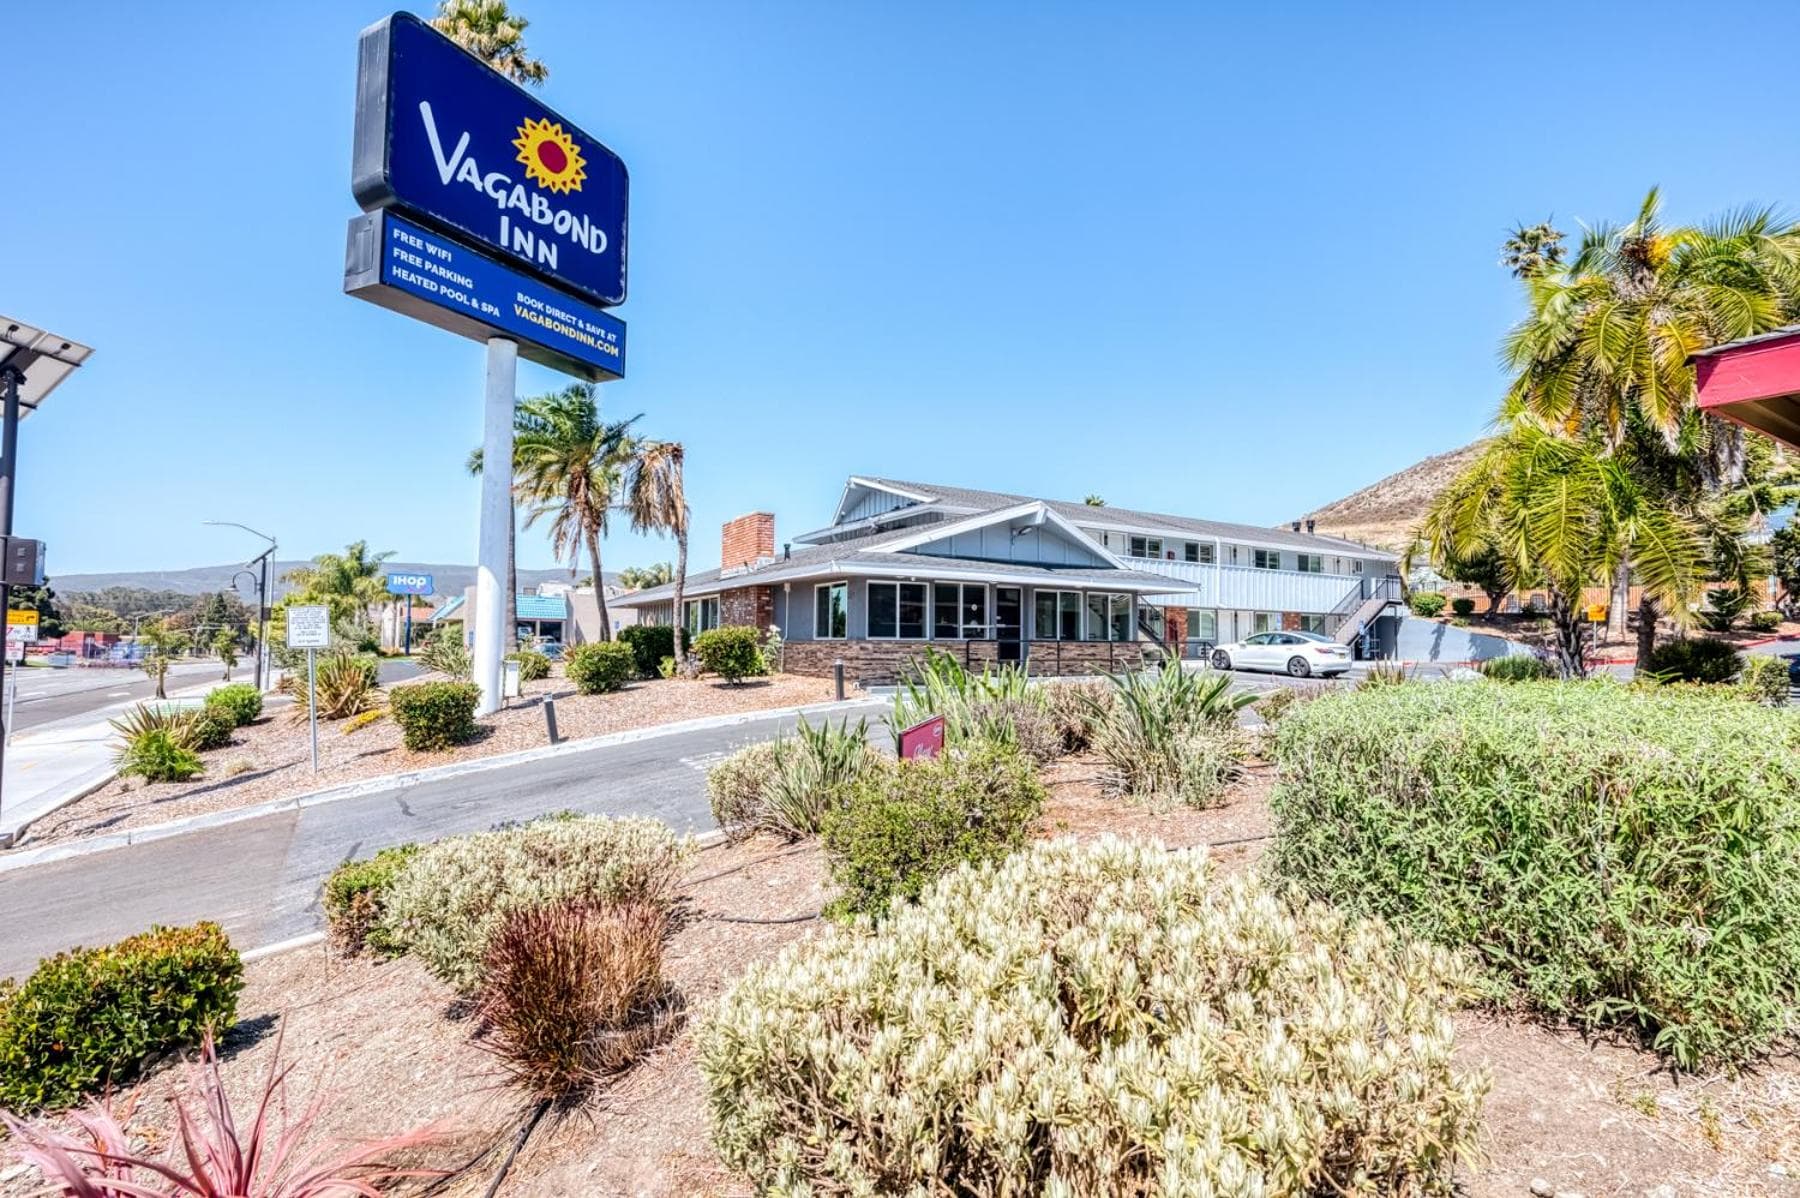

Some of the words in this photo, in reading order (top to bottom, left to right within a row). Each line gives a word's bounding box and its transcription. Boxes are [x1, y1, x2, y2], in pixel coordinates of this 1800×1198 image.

[419, 100, 608, 254] VAGABOND
[393, 228, 424, 250] FREE
[425, 242, 452, 262] WIFI
[393, 247, 423, 268] FREE
[424, 260, 473, 289] PARKING
[500, 216, 558, 270] INN
[392, 265, 438, 292] HEATED
[440, 285, 470, 306] POOL
[471, 298, 479, 309] &
[481, 302, 500, 317] SPA
[517, 292, 544, 311] BOOK
[545, 305, 577, 325] DIRECT
[578, 319, 584, 328] &
[585, 322, 606, 337] SAVE
[607, 333, 617, 342] AT
[513, 303, 619, 357] VAGABONDINN.COM
